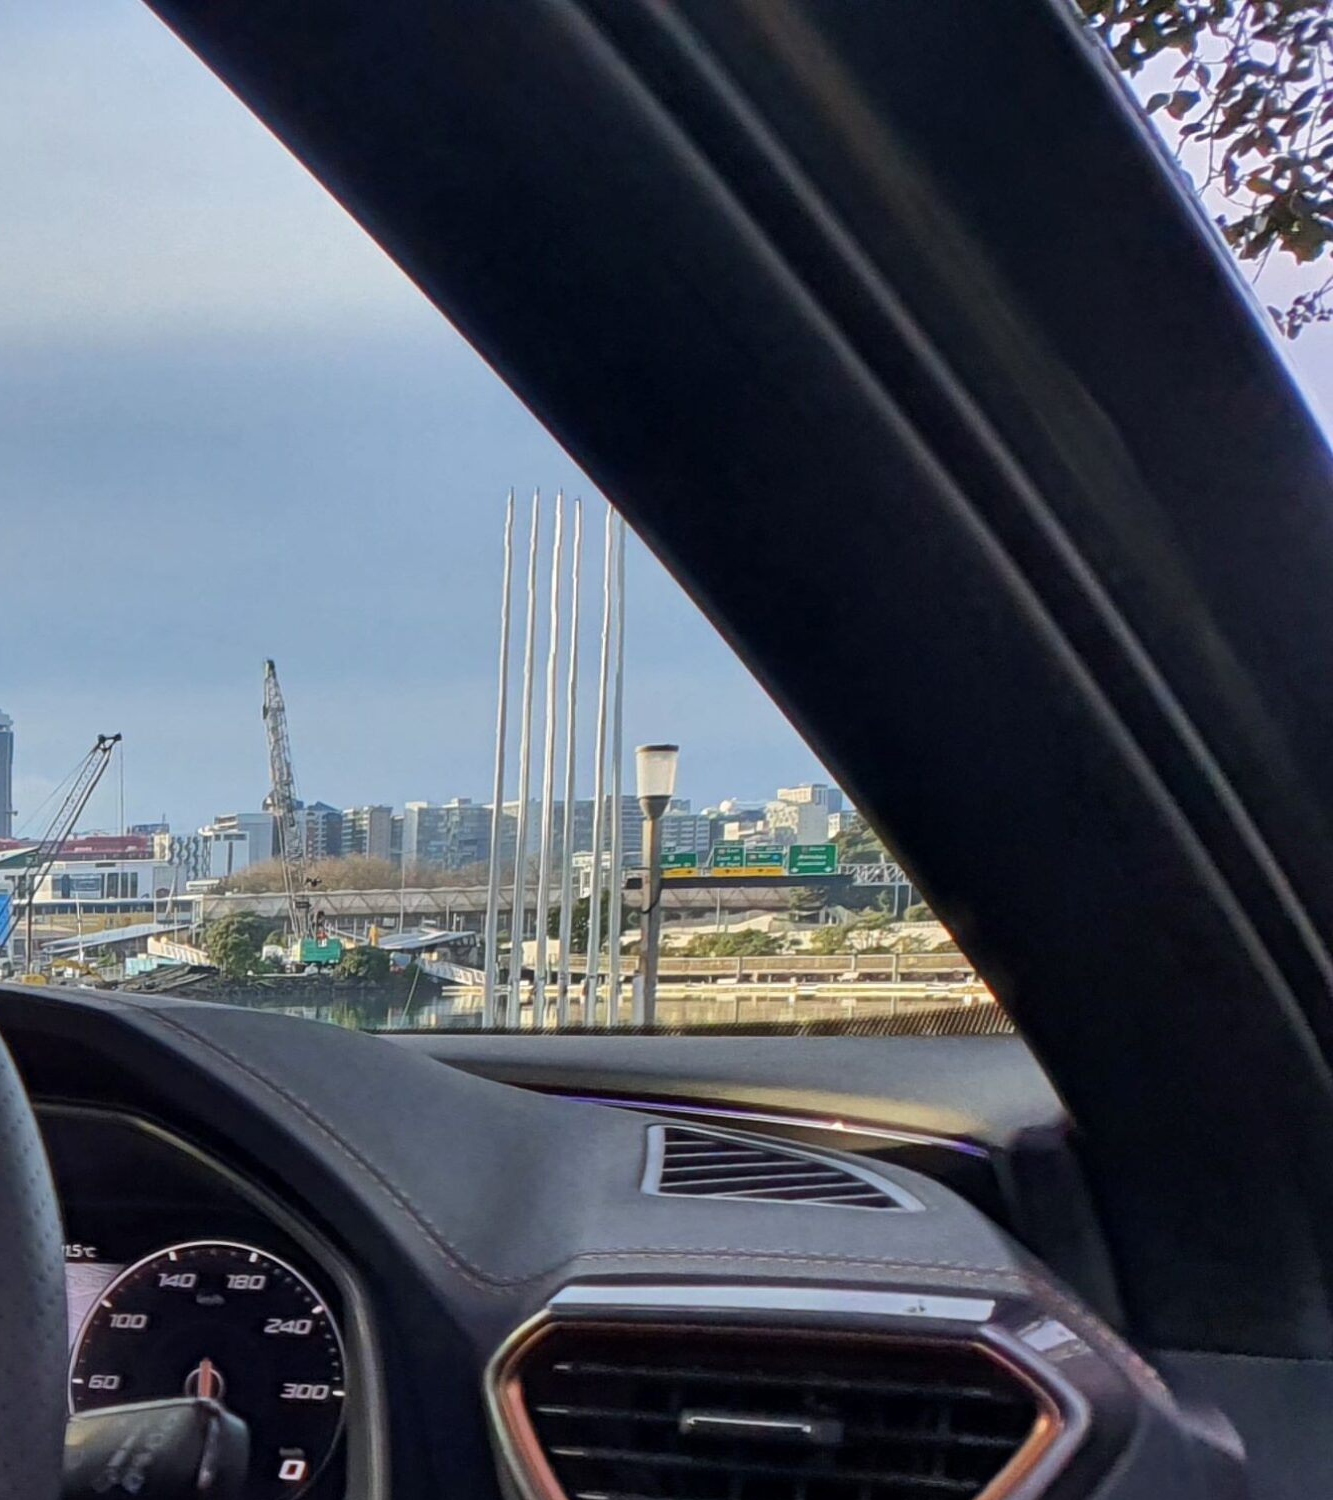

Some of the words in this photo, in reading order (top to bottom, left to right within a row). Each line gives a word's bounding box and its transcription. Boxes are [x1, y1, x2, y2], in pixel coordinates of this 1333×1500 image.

[157, 1273, 198, 1289] 140
[226, 1274, 267, 1290] 180
[109, 1313, 148, 1330] 100
[263, 1318, 313, 1335] 240
[87, 1374, 121, 1390] 60
[279, 1383, 330, 1400] 300
[277, 1459, 306, 1481] 0
